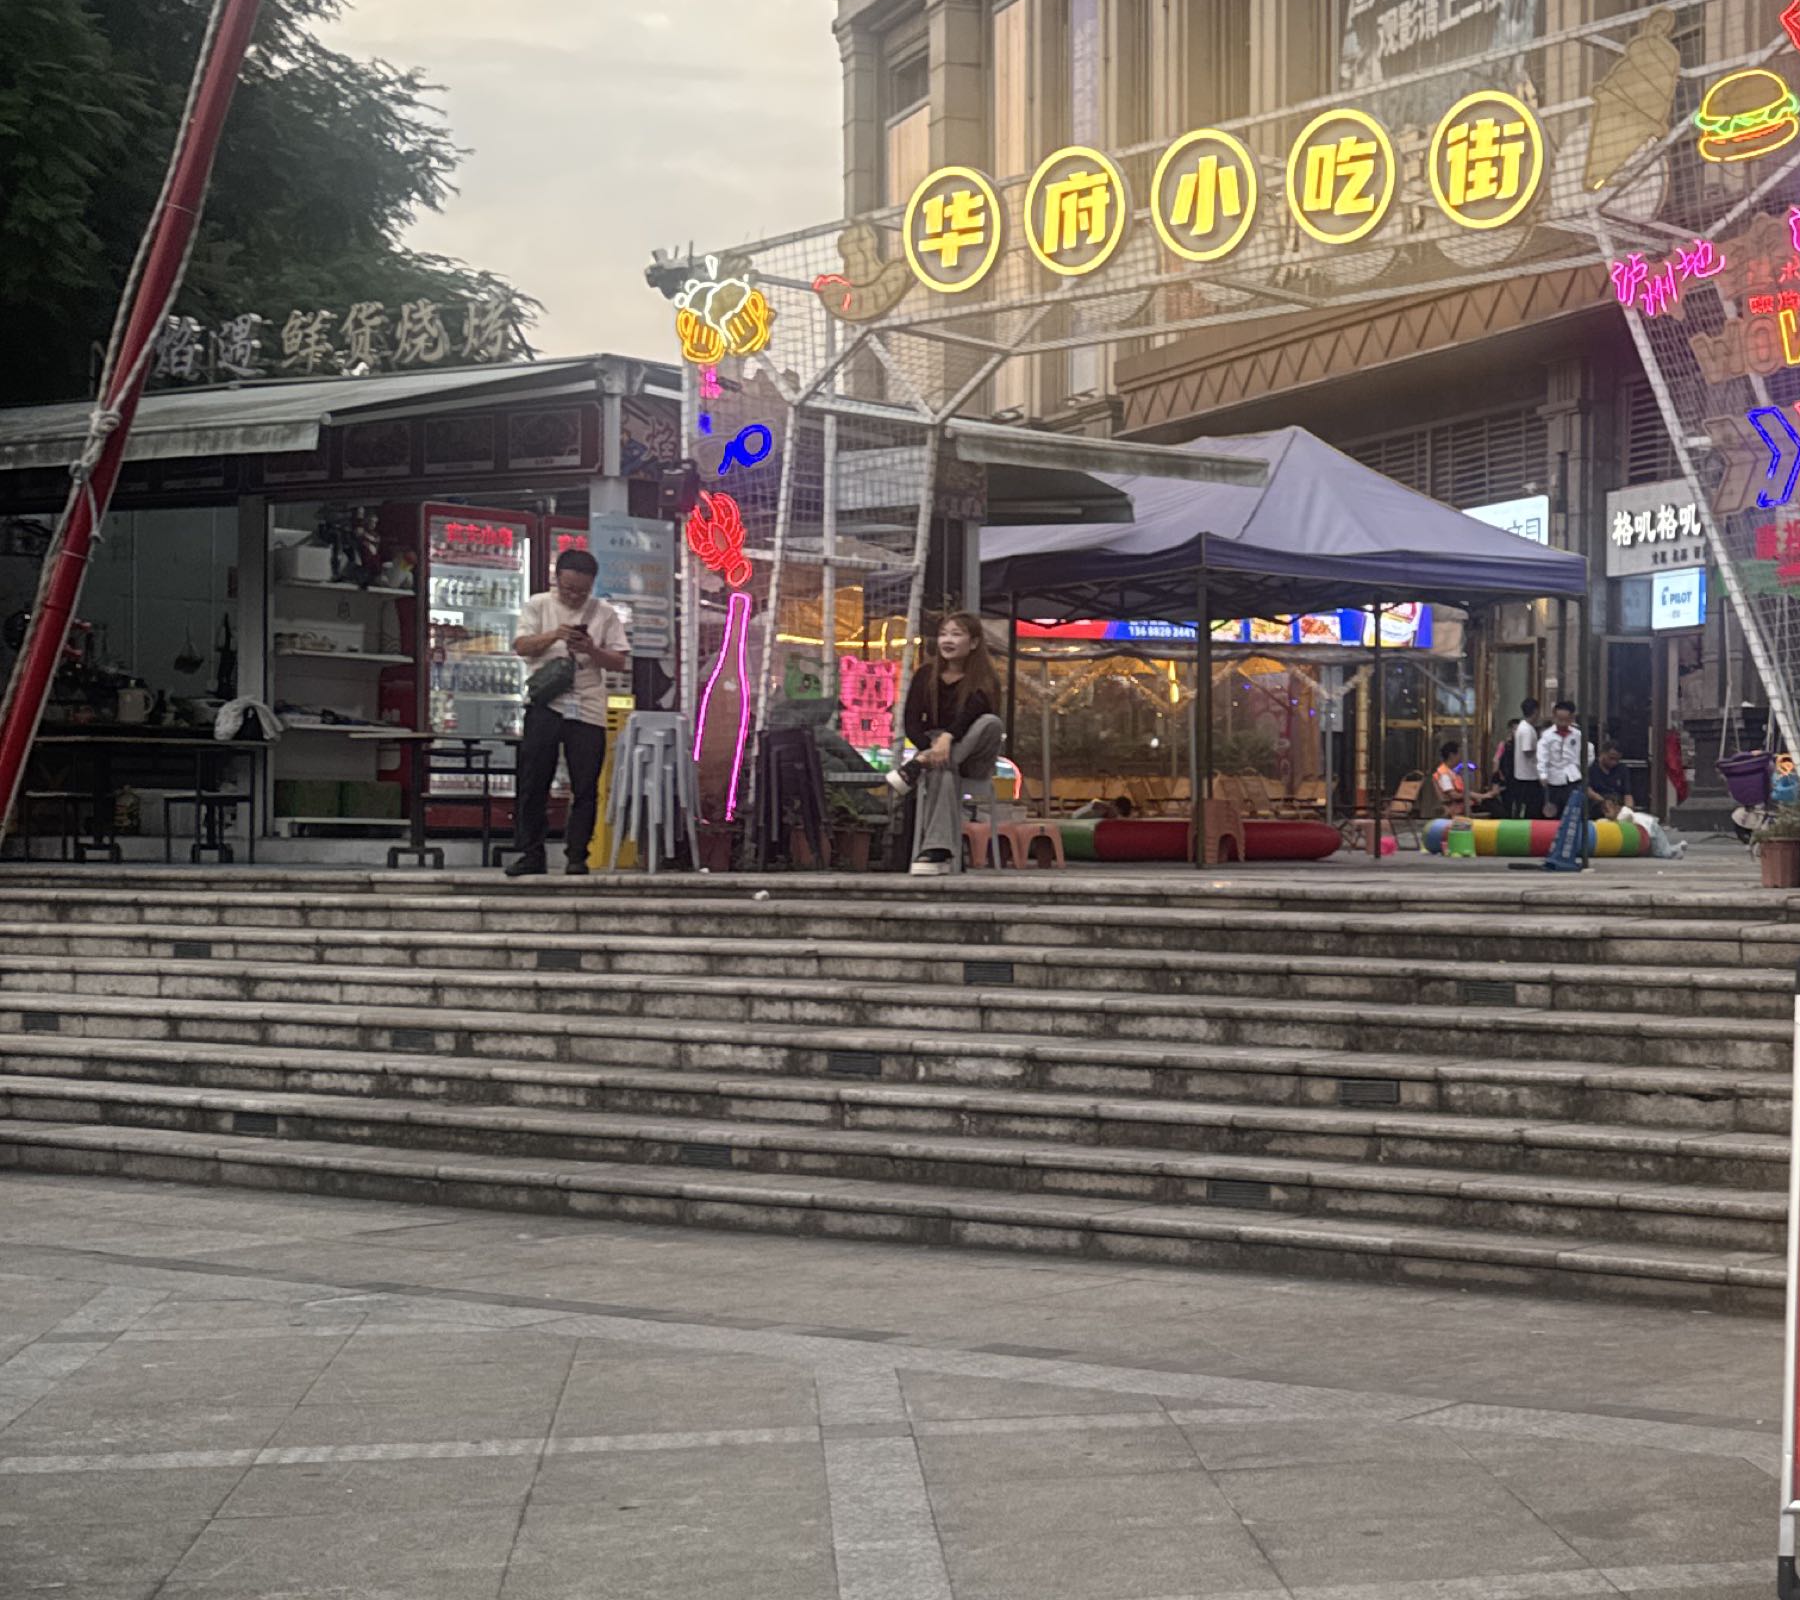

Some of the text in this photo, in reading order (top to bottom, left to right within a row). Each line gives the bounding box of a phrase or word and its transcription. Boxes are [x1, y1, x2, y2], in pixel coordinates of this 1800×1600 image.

[917, 116, 1526, 268] 华府小吃街
